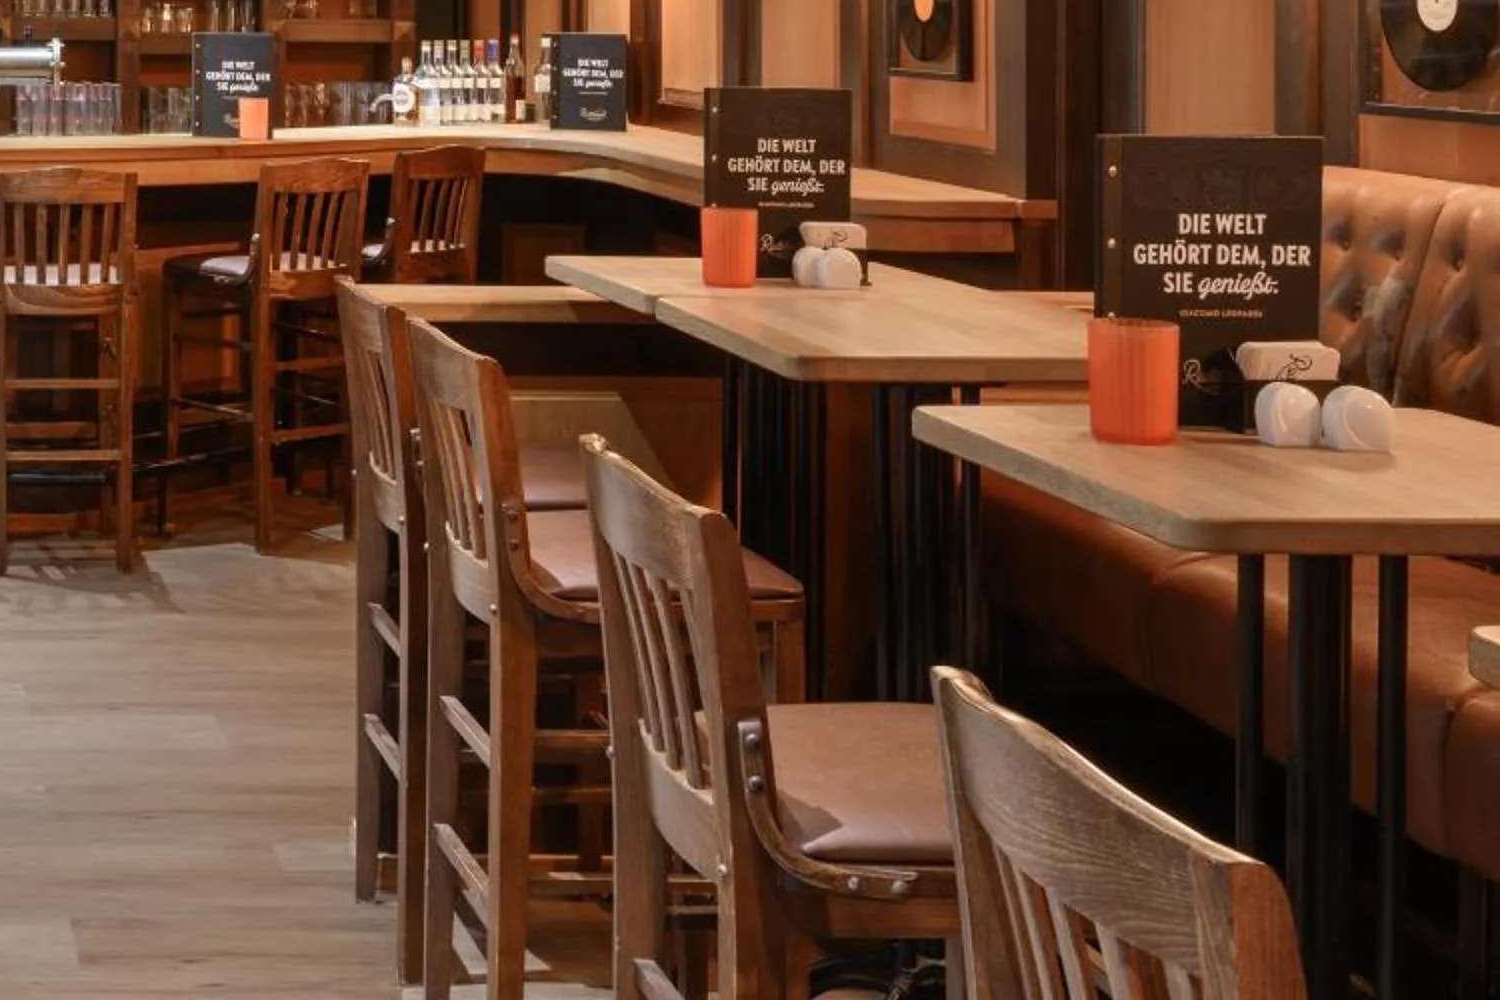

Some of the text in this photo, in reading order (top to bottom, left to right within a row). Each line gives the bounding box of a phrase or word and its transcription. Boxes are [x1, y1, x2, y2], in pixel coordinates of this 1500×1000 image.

[757, 138, 817, 153] DIE WELT
[727, 155, 846, 176] GEHÖRT DEM, DER
[747, 177, 768, 191] SIE
[1178, 213, 1267, 235] DIE WELT
[1133, 239, 1311, 268] GEHÖRT DEM, DER
[1163, 272, 1279, 299] SIE genießt.
